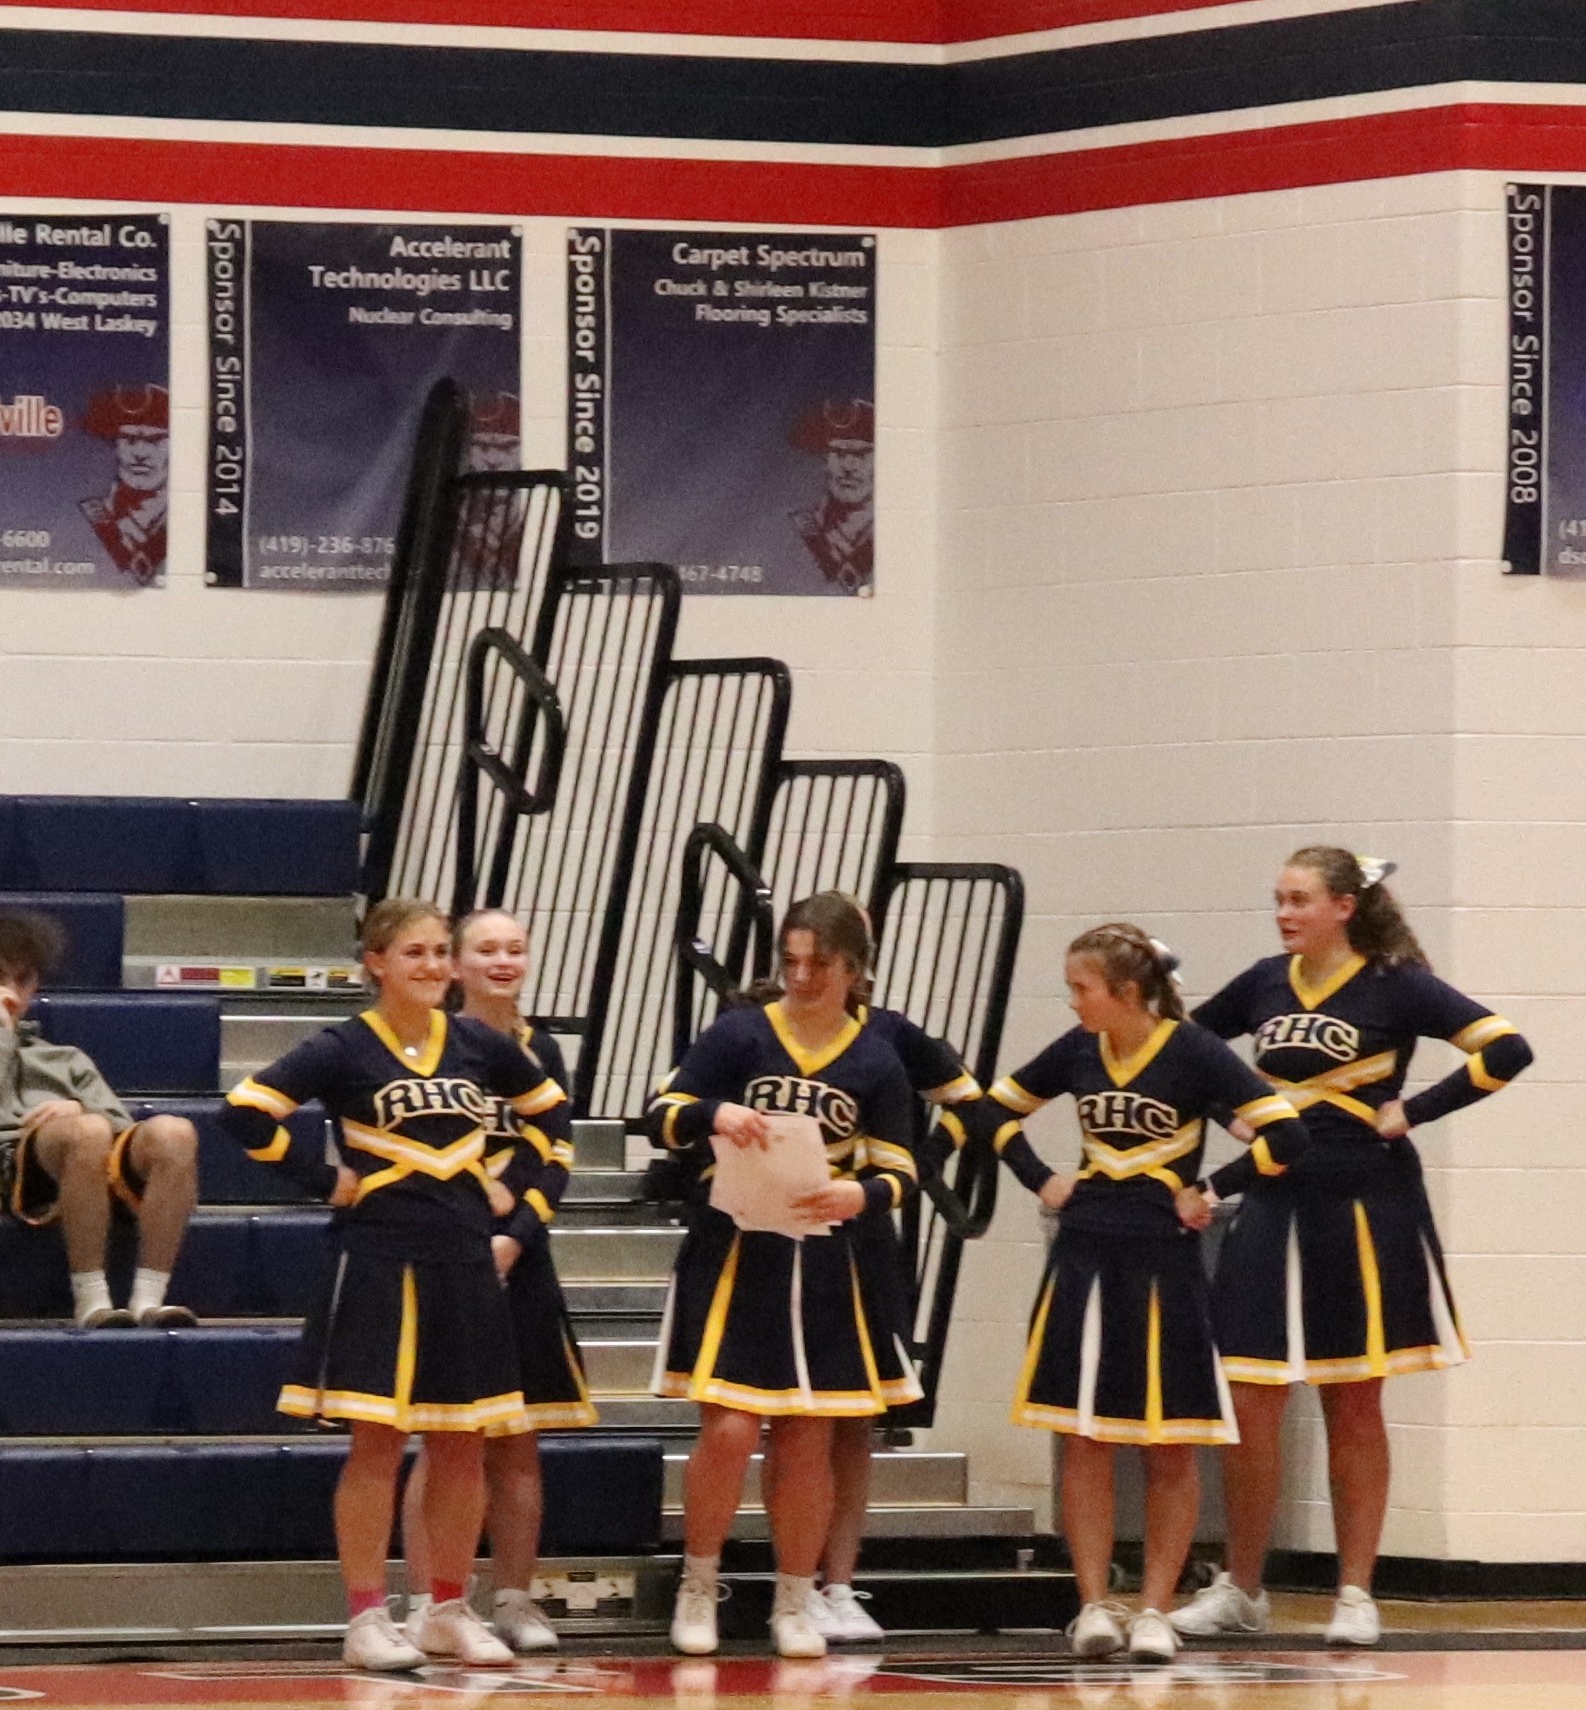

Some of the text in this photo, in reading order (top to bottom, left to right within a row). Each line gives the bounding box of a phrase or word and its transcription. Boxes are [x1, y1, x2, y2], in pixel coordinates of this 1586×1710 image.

[36, 223, 111, 249] Rental
[119, 224, 156, 249] Co.
[390, 236, 511, 259] Accelerant
[672, 243, 865, 271] Carpet Spectrum
[309, 266, 510, 294] Technologies LLC
[654, 278, 707, 296] Chuck
[714, 279, 728, 296] &
[41, 312, 90, 332] West
[95, 313, 156, 337] Laskey
[349, 307, 513, 331] Nuclear Consulting
[695, 304, 867, 327] Flooring Specialists
[1509, 193, 1540, 504] Sponsor Since 2008
[212, 223, 243, 516] Sponsor Since 2014
[569, 235, 601, 540] Sponsor Since 2019
[259, 536, 395, 555] (419)-236-876
[743, 1075, 858, 1137] RHC
[1078, 1091, 1179, 1140] RHC
